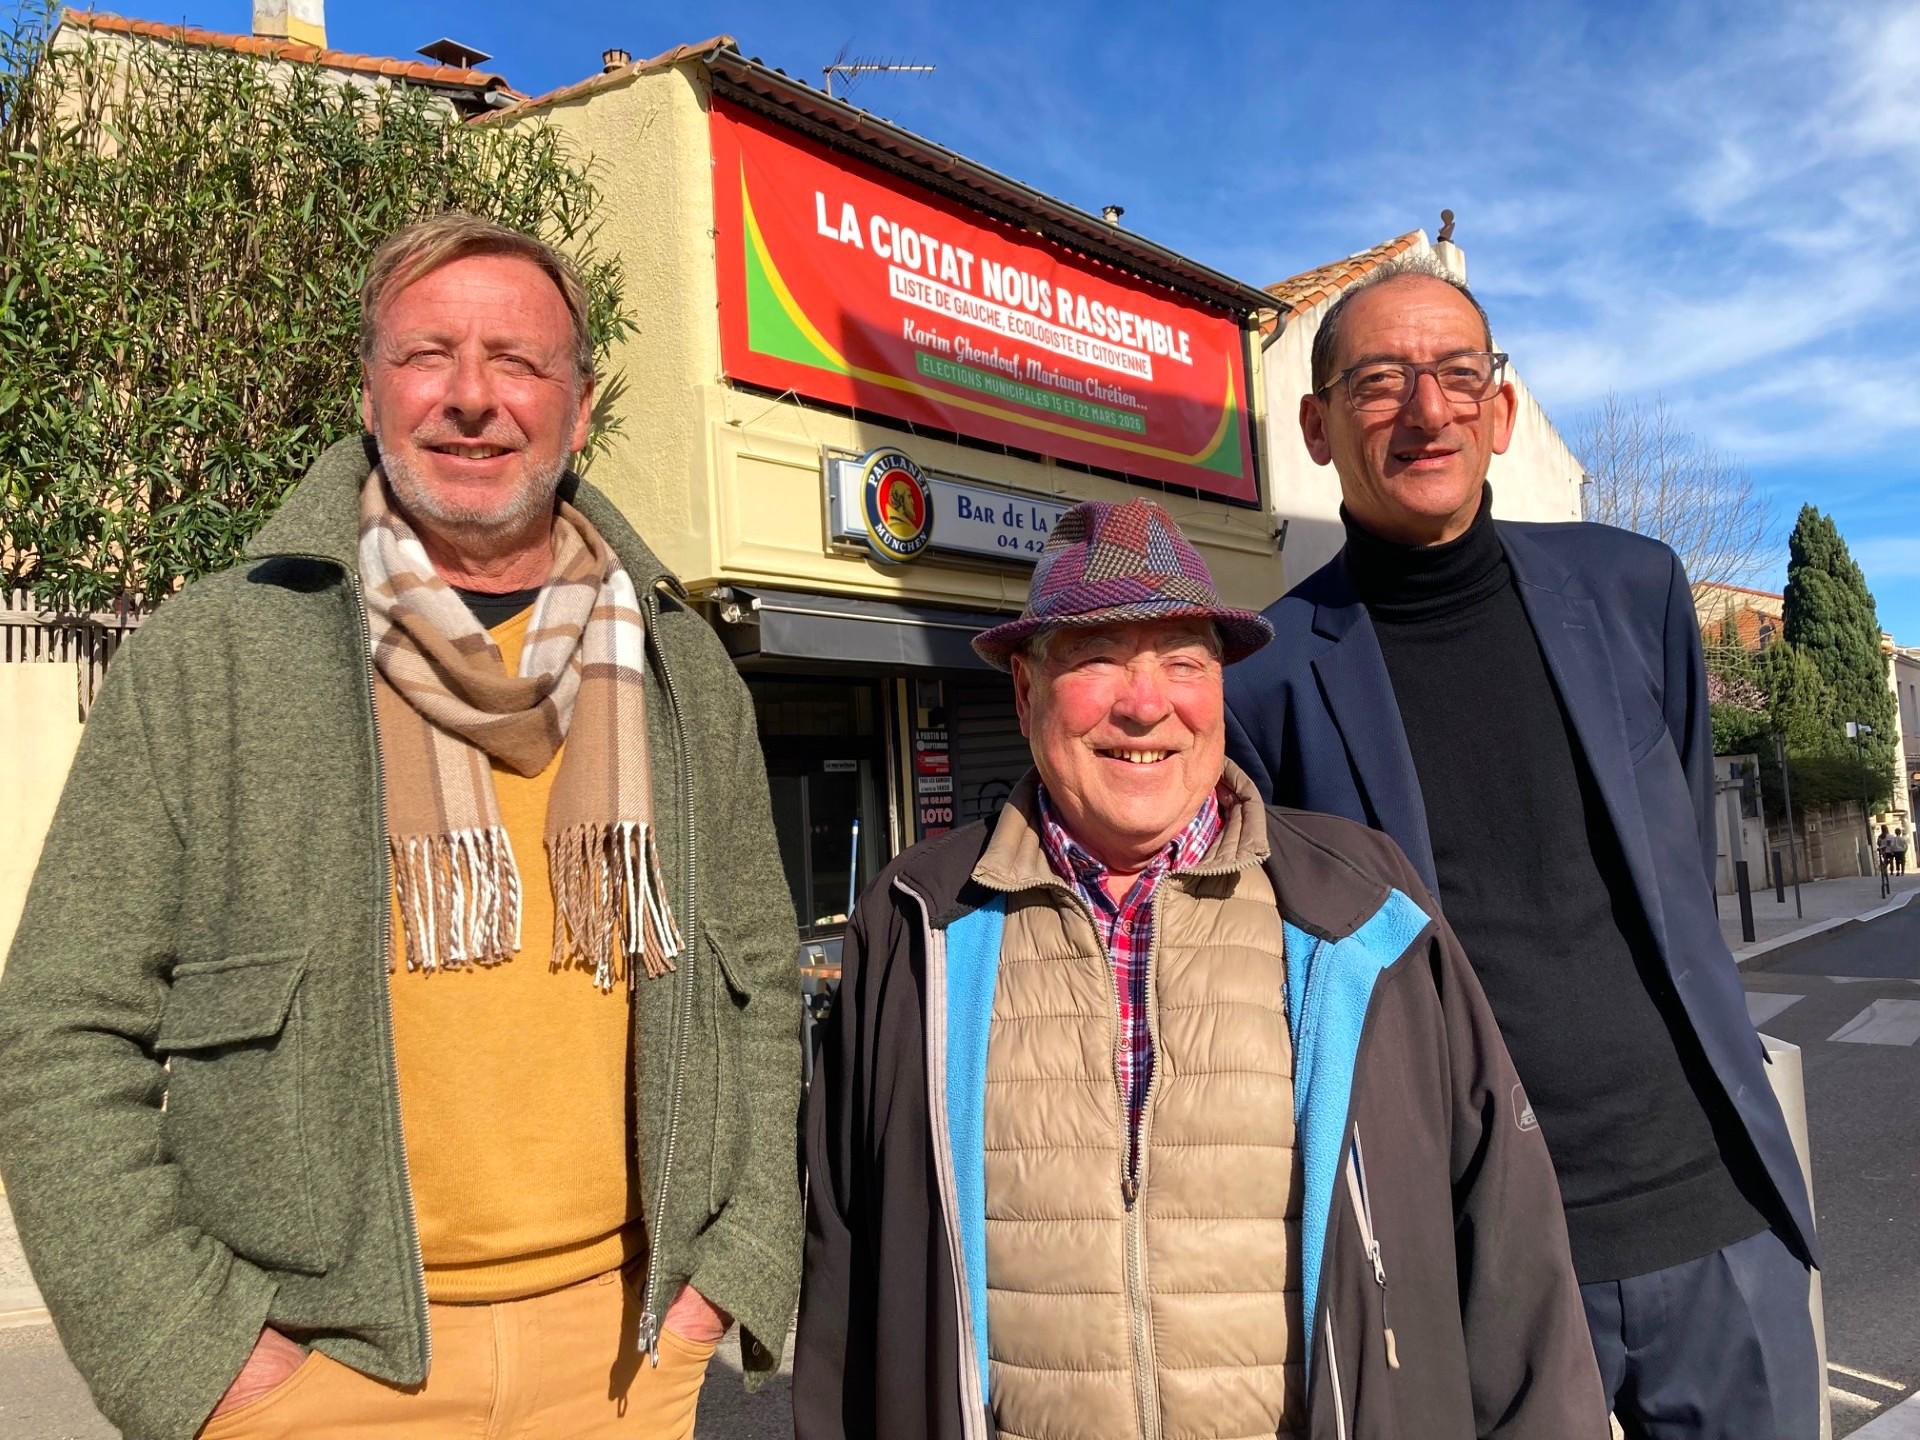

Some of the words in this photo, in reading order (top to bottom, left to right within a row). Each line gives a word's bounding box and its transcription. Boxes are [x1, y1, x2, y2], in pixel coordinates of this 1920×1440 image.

[815, 190, 864, 249] LA
[869, 214, 974, 290] CIOTAT
[981, 258, 1053, 318] NOUS
[1056, 287, 1194, 366] RASSEMBLE
[895, 273, 932, 305] LISTE
[935, 288, 952, 311] DE
[953, 296, 1006, 331] GAUCHE,
[1007, 312, 1075, 353] ÉCOLOGISTE
[1076, 338, 1090, 356] ET
[1091, 343, 1149, 376] CITOYENNE
[903, 317, 951, 353] Karim
[953, 335, 1023, 380] Ghendouf,
[1026, 357, 1083, 395] Mariann
[922, 354, 982, 381] ÉLECTIONS
[984, 376, 1051, 407] MUNICIPALES
[1052, 395, 1062, 410] 15
[1063, 400, 1077, 414] ET
[1078, 404, 1090, 418] 22
[1091, 408, 1117, 425] MARS
[1119, 413, 1142, 431] 2026
[867, 455, 930, 496] PAULANER
[997, 534, 1019, 550] 04
[1024, 540, 1045, 554] 42
[921, 808, 953, 824] LOTO
